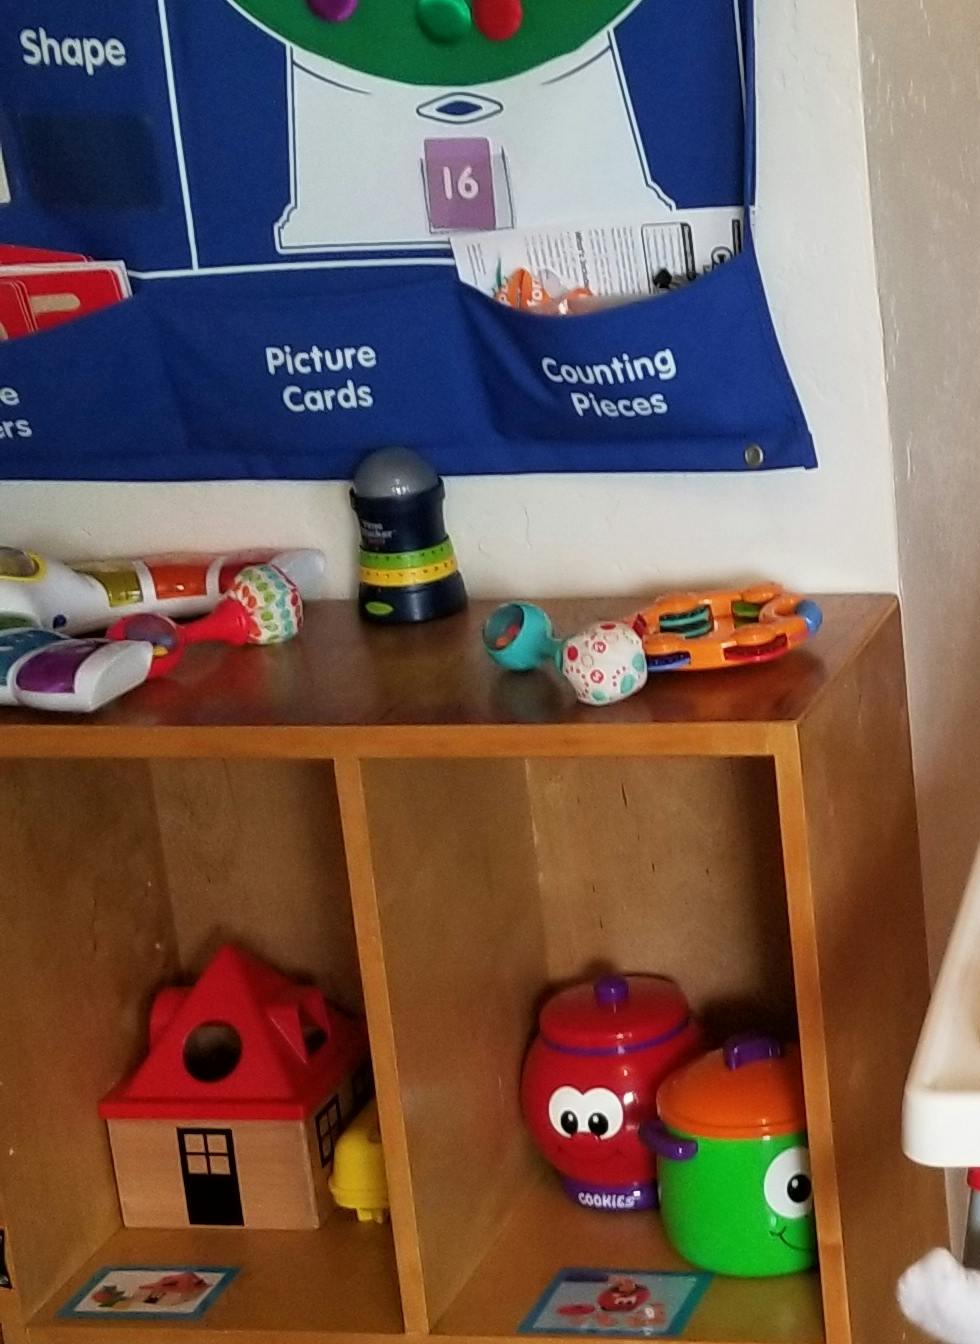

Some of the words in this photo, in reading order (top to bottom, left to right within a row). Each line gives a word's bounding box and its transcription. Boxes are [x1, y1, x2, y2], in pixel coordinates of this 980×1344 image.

[20, 27, 127, 76] Shape
[442, 164, 480, 201] 16
[265, 344, 377, 375] Picture
[542, 348, 677, 386] Counting
[282, 379, 374, 412] Cards
[570, 391, 668, 418] Pieces
[577, 1192, 635, 1209] COOKIES
